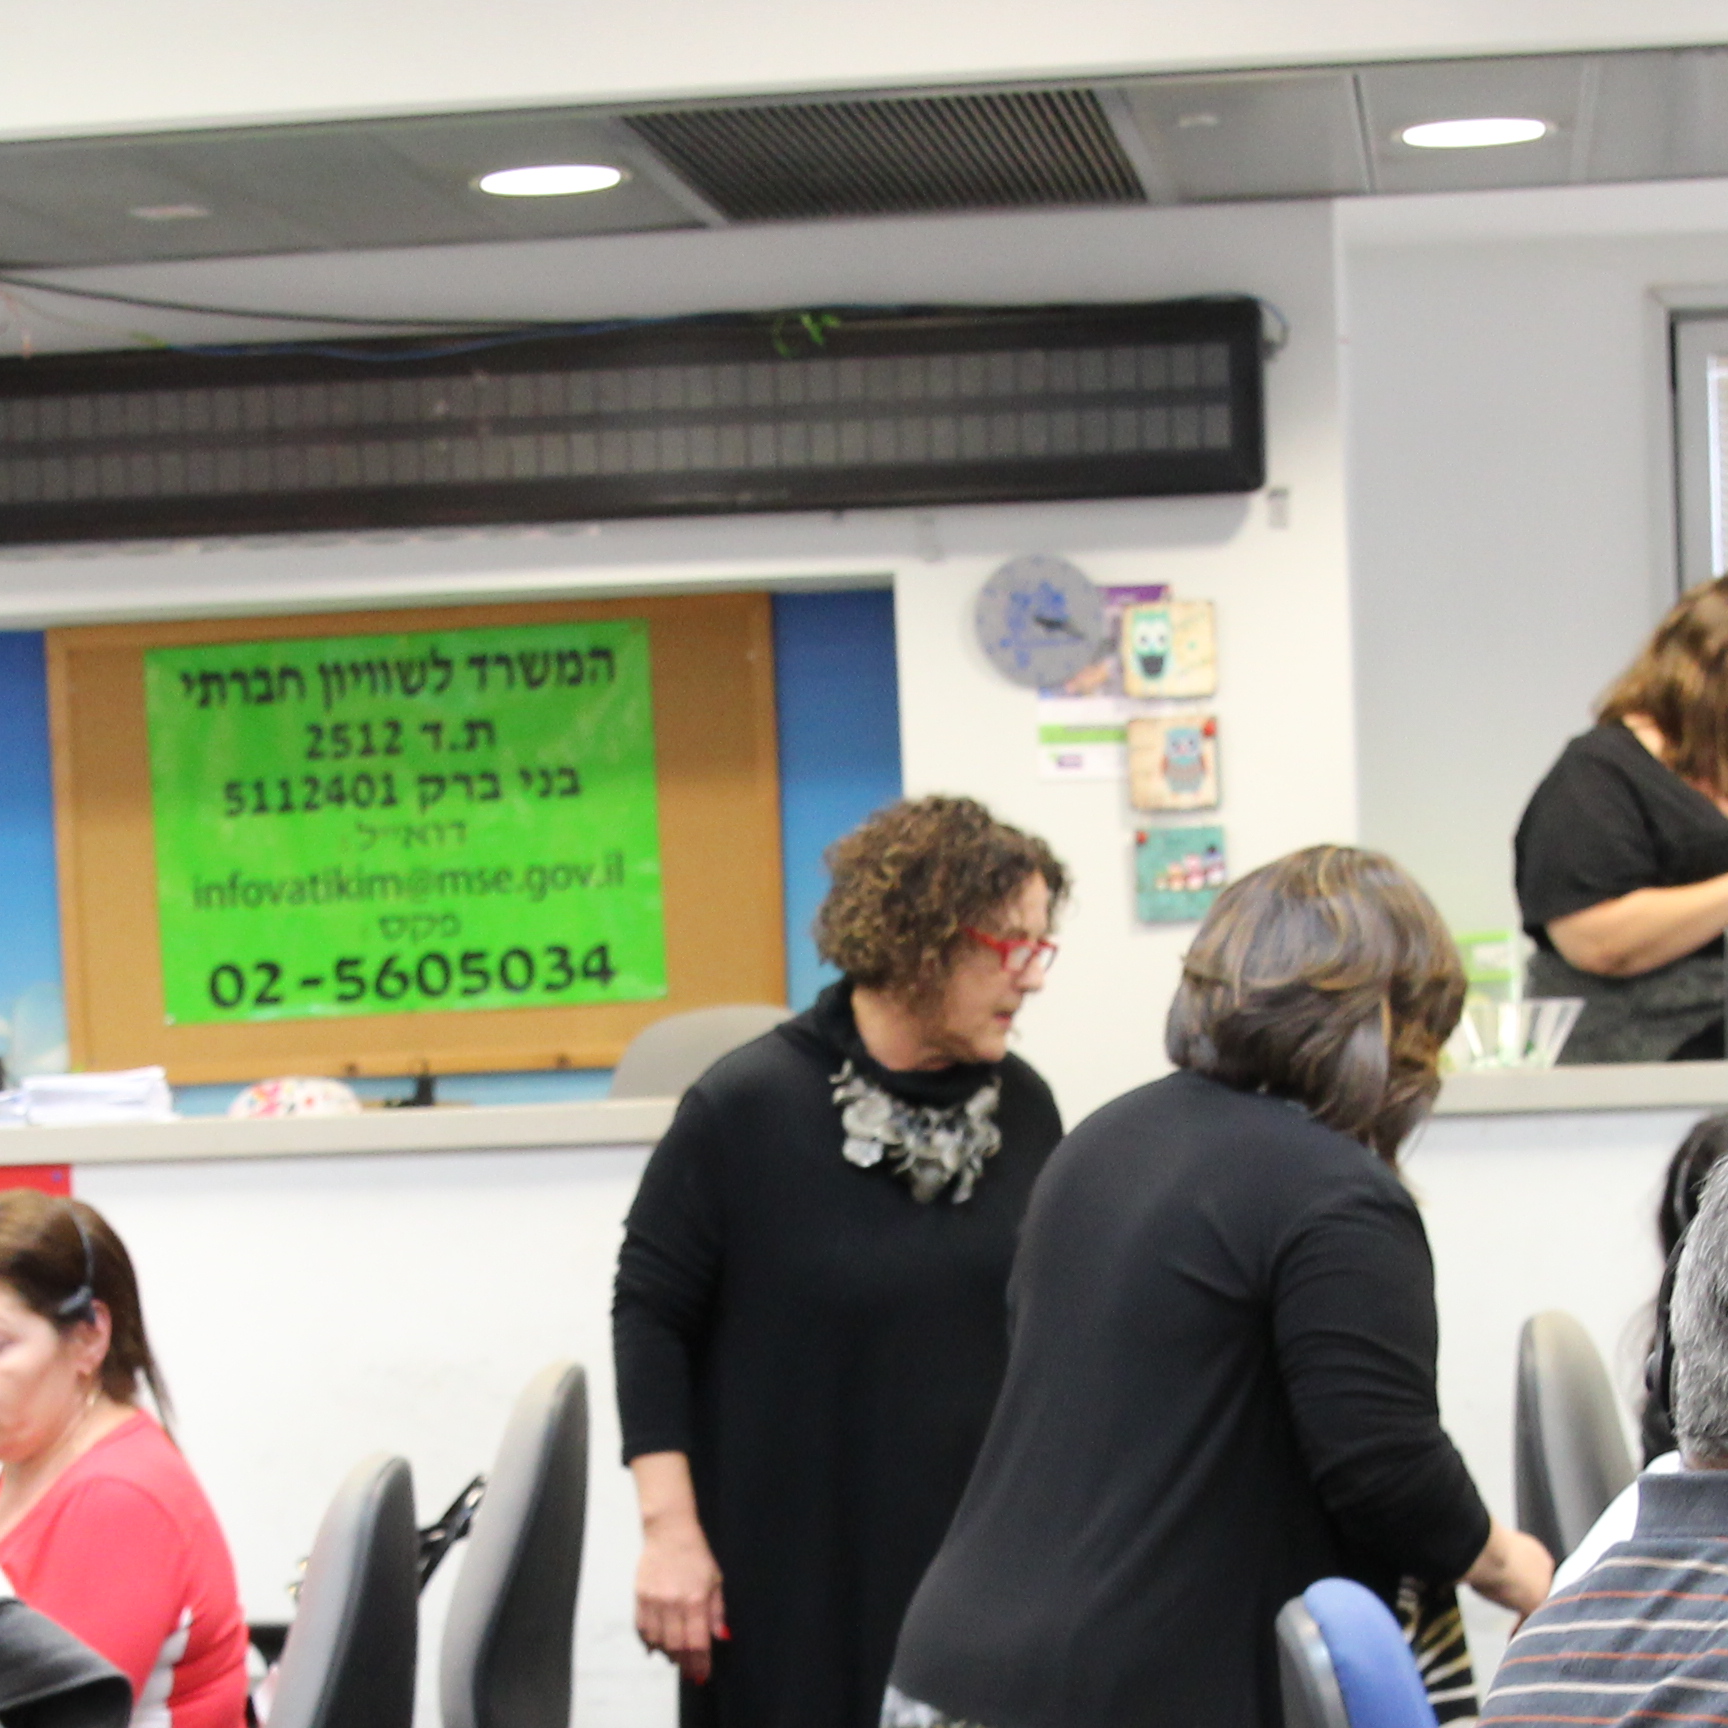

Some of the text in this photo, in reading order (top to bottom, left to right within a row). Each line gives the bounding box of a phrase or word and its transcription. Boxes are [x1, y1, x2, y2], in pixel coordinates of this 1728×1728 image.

[179, 645, 616, 712] המשרד לשוויון חברתי
[305, 719, 405, 762] 2512
[223, 765, 582, 818] בני ברק 5112401
[193, 851, 625, 911] infovatikim@mse.gov.il
